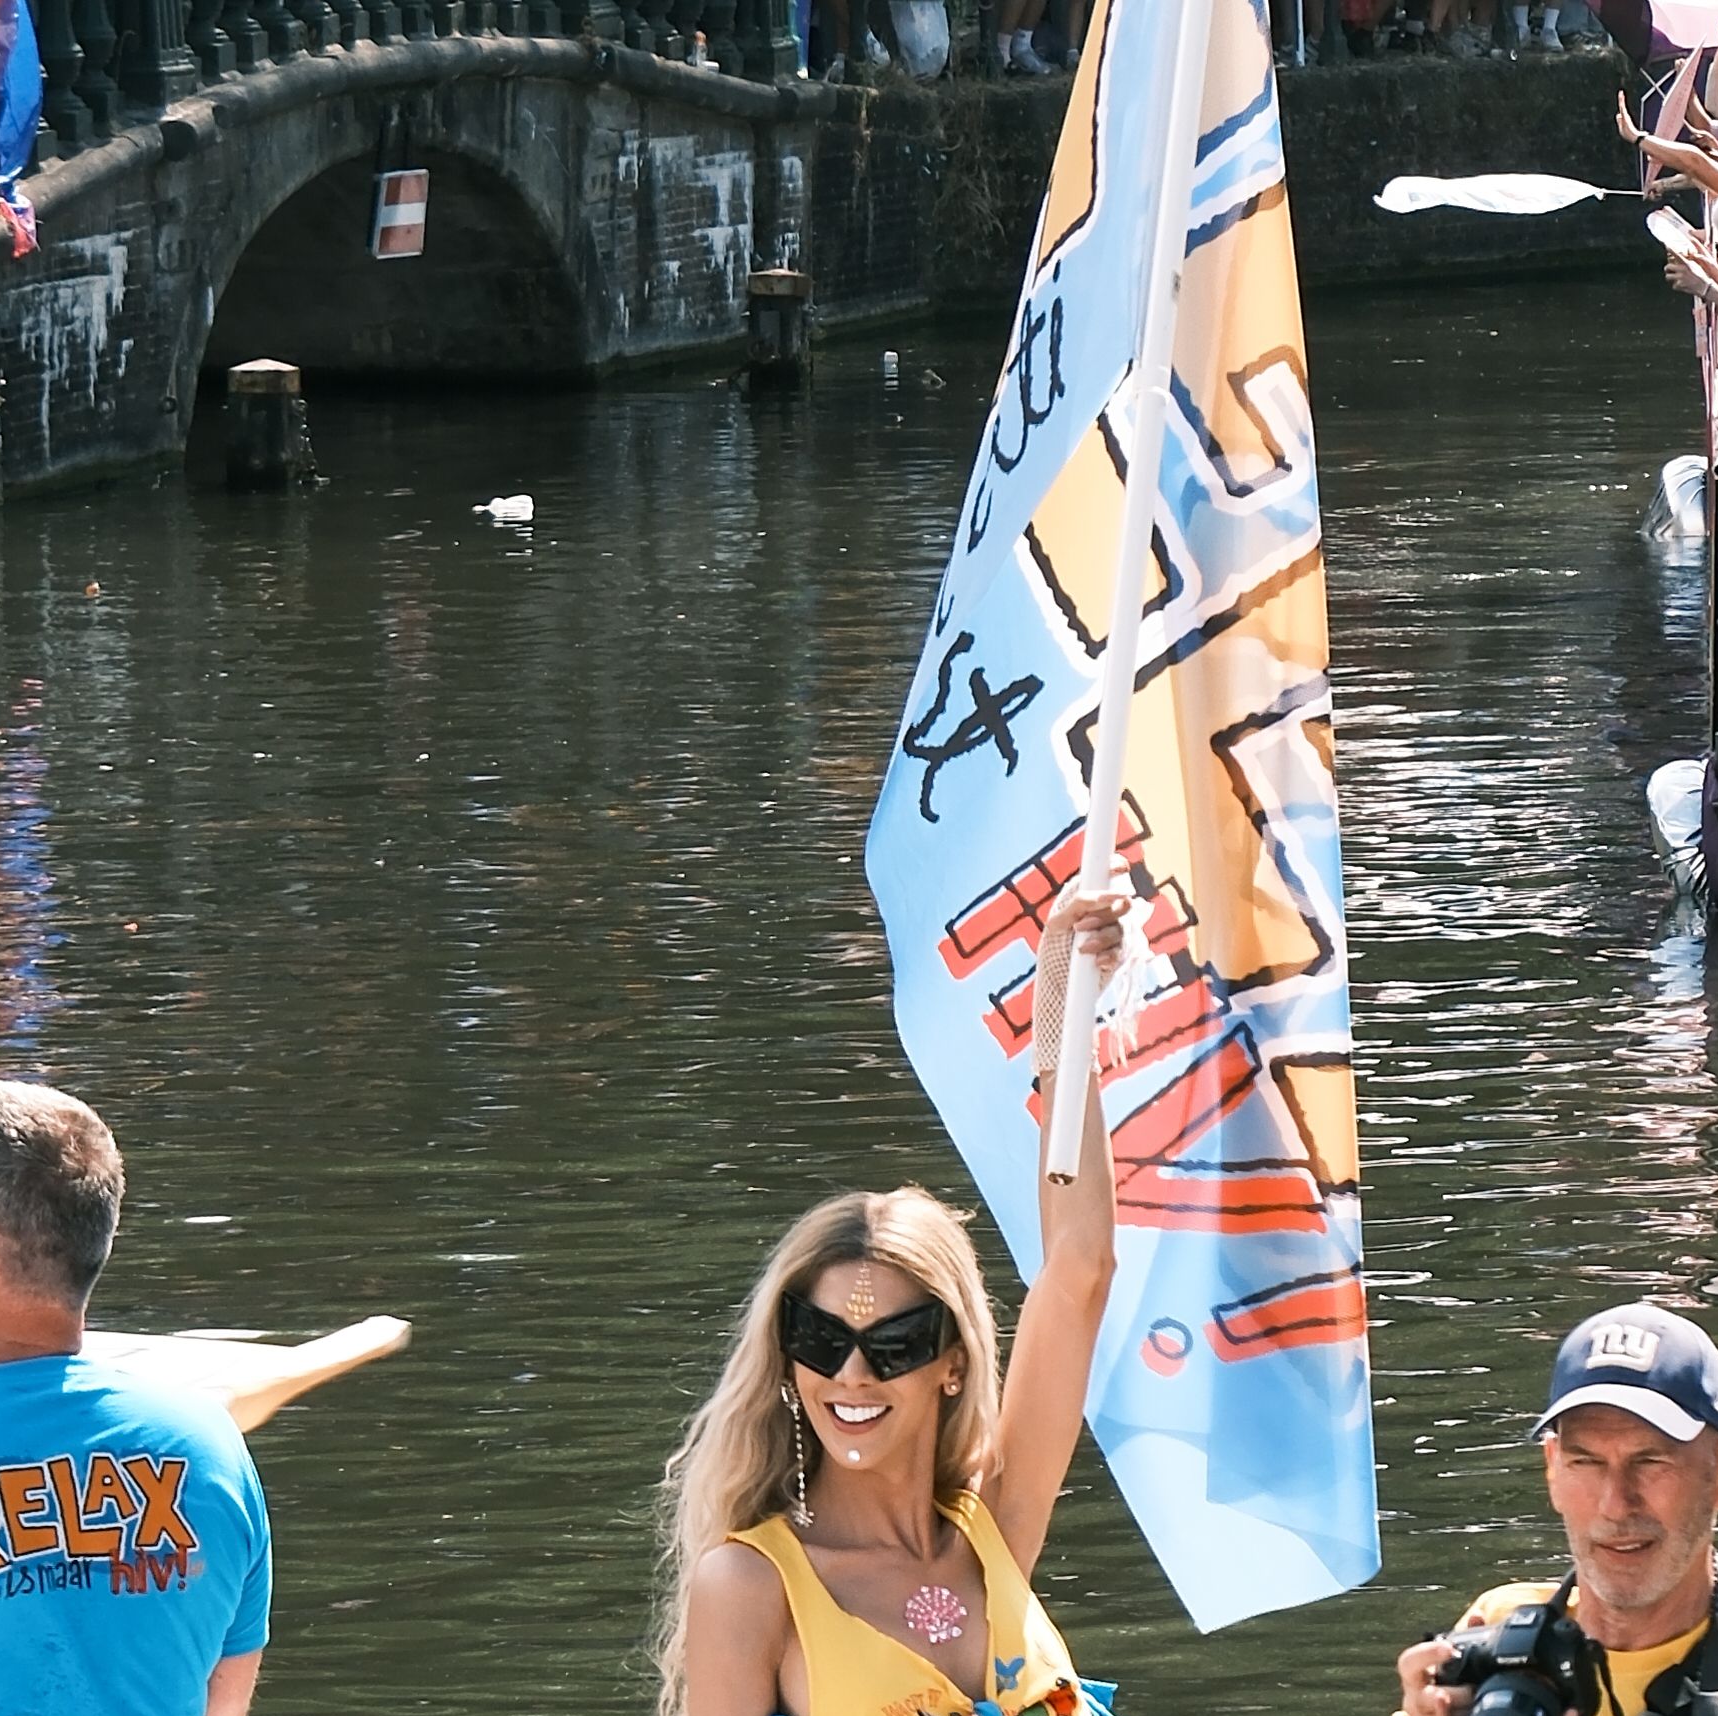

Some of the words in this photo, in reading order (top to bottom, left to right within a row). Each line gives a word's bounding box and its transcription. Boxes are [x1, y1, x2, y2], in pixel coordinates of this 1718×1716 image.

[5, 1565, 35, 1598] is
[38, 1559, 93, 1595] maar
[110, 1544, 188, 1595] hiv!
